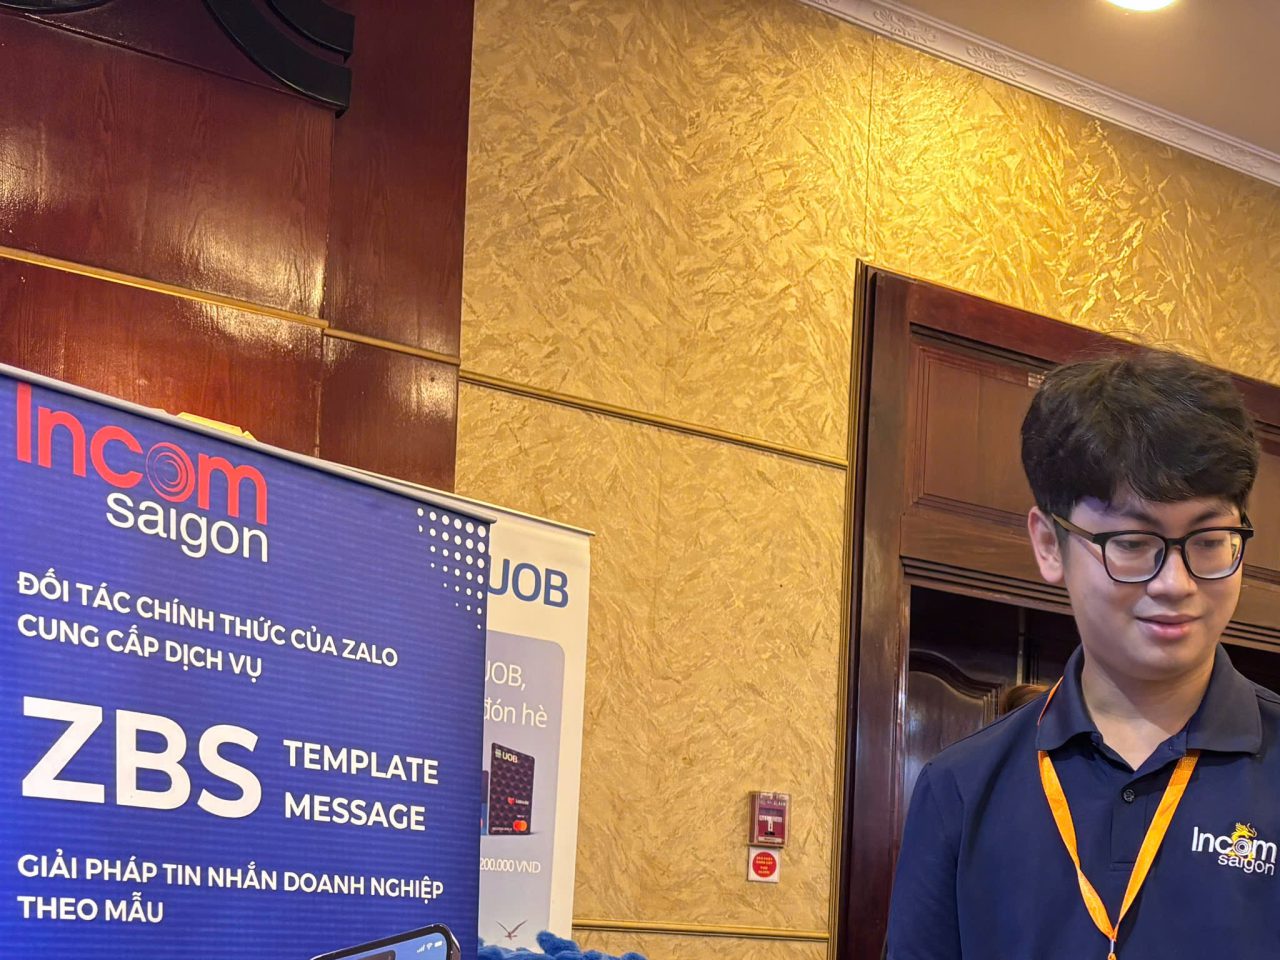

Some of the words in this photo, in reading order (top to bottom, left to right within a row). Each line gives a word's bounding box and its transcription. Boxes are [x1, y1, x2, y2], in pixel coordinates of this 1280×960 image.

[17, 383, 268, 525] Incom
[106, 492, 268, 562] saigon
[17, 568, 69, 602] ĐỐI
[76, 582, 131, 614] TÁC
[136, 595, 214, 632] CHÍNH
[220, 613, 285, 645] THỨC
[291, 625, 338, 656] CỦA
[342, 638, 398, 667] ZALO
[17, 613, 99, 648] CUNG
[106, 624, 159, 658] CẤP
[165, 640, 223, 671] DỊCH
[229, 652, 262, 683] VỤ
[522, 703, 547, 727] hè
[22, 695, 262, 818] ZBS
[283, 739, 439, 785] TEMPLATE
[502, 752, 518, 763] UOB
[285, 792, 425, 831] MESSAGE
[1192, 827, 1277, 863] Incom
[1218, 855, 1275, 875] saigon
[17, 848, 77, 879] GIẢI
[86, 855, 157, 883] PHÁP
[163, 863, 201, 886] TIN
[208, 860, 277, 891] NHẮN
[284, 873, 365, 895] DOANH
[370, 875, 443, 903] NGHIỆP
[515, 861, 540, 873] VND
[17, 896, 98, 921] THEO
[105, 891, 163, 923] MẪU
